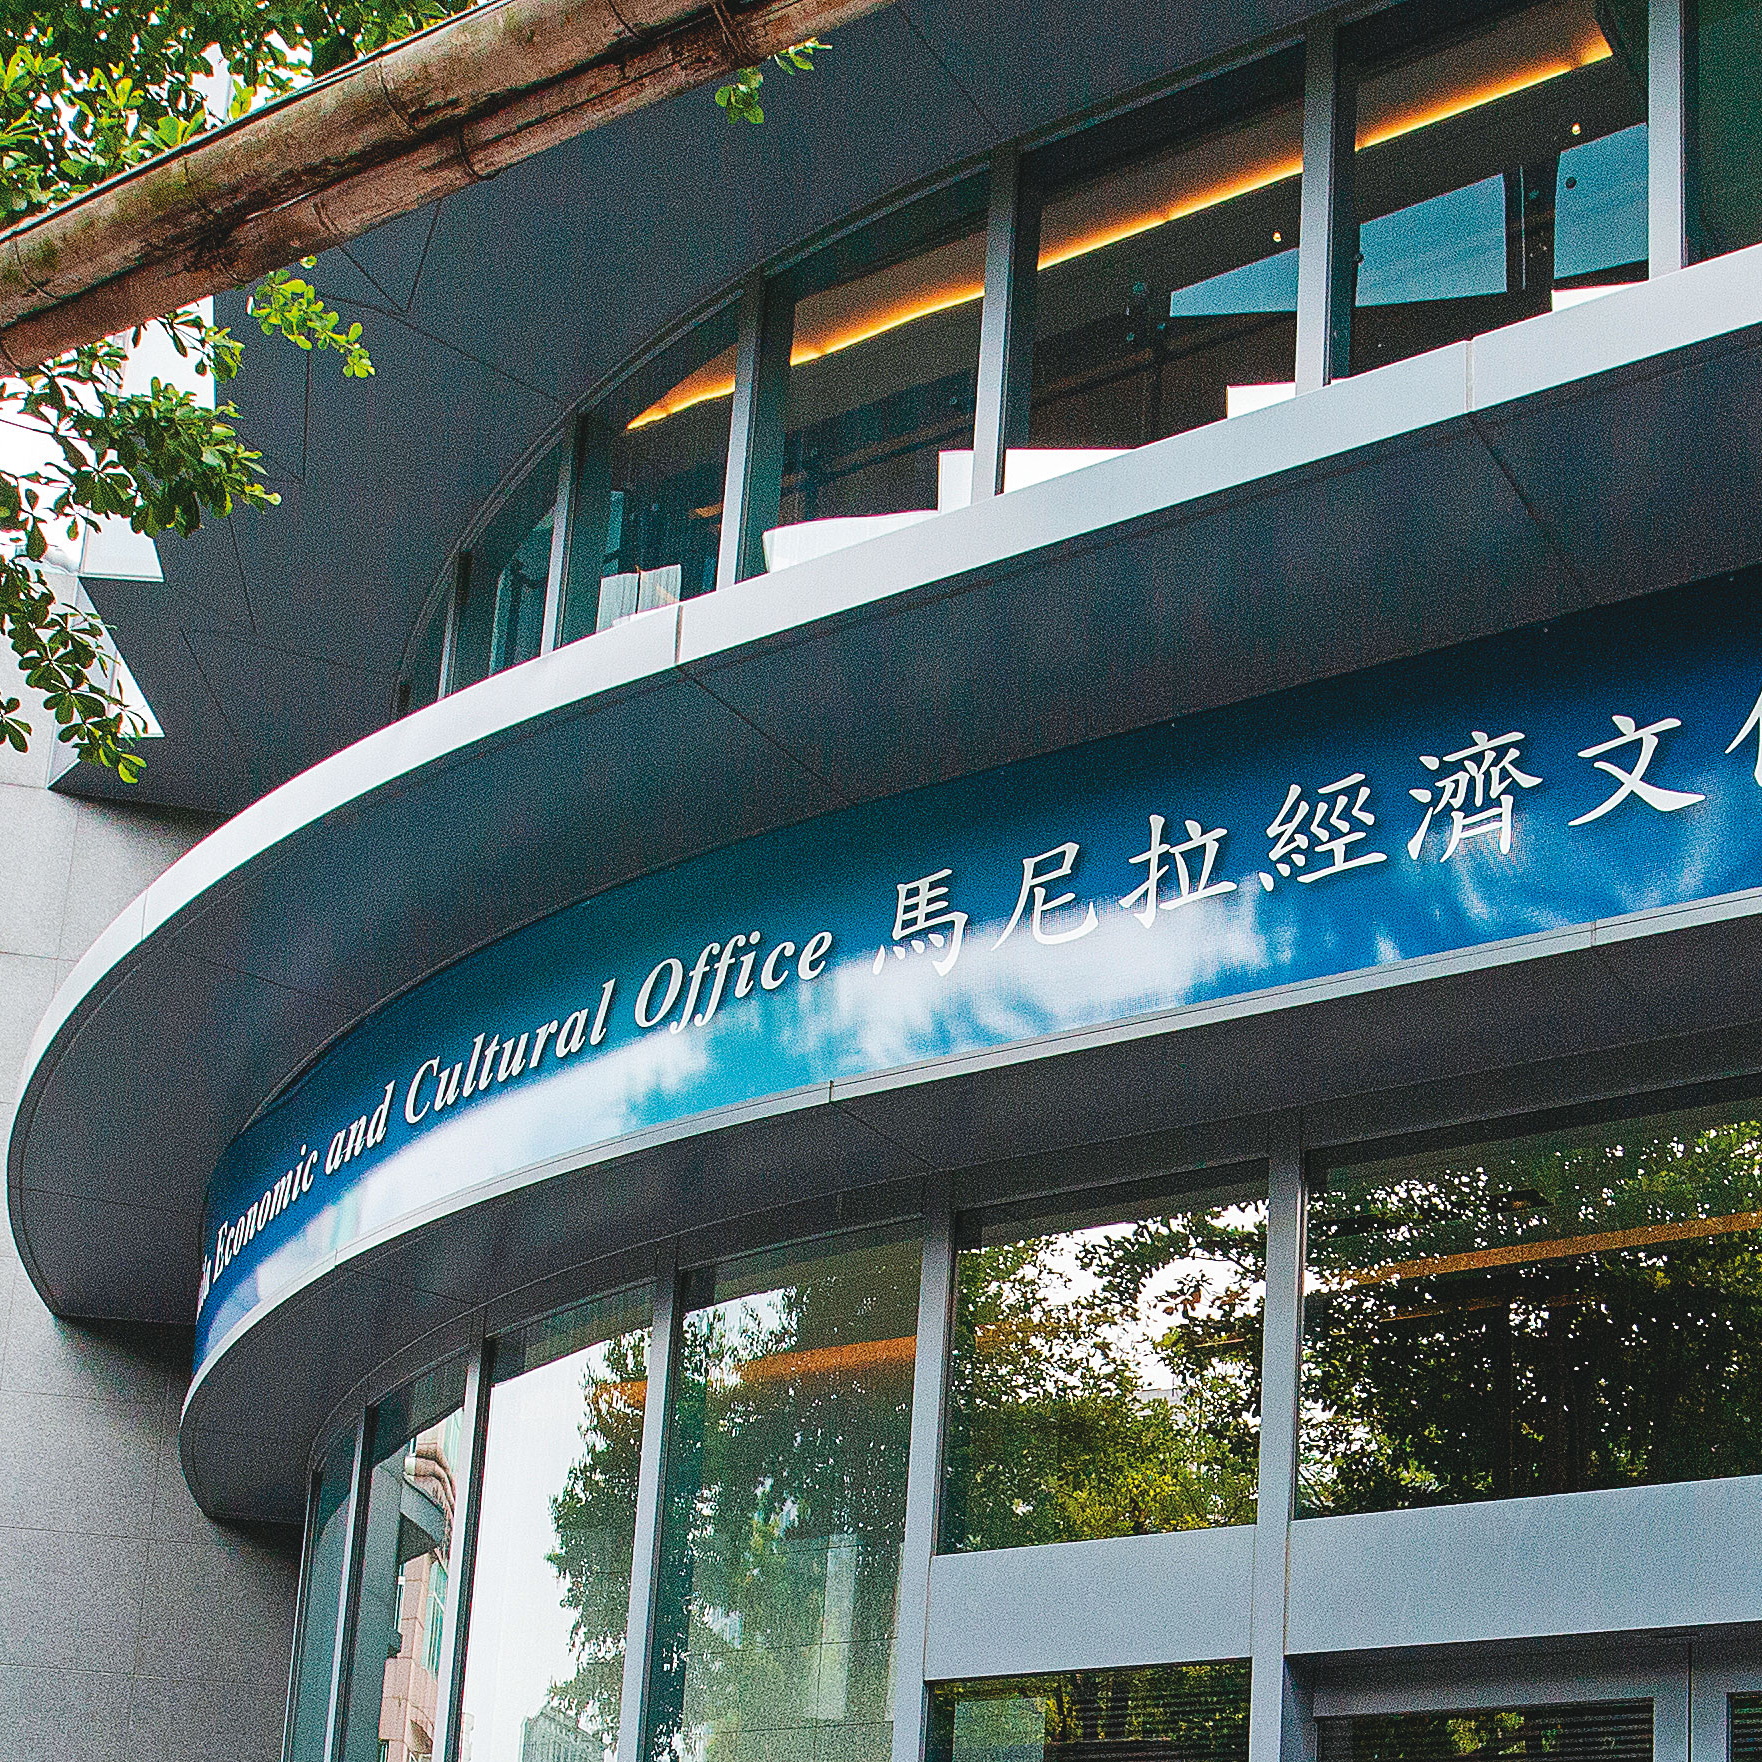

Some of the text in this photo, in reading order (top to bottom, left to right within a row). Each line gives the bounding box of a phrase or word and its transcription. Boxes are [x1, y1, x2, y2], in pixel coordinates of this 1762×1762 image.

[213, 931, 832, 1284] Economic and Cultural Office
